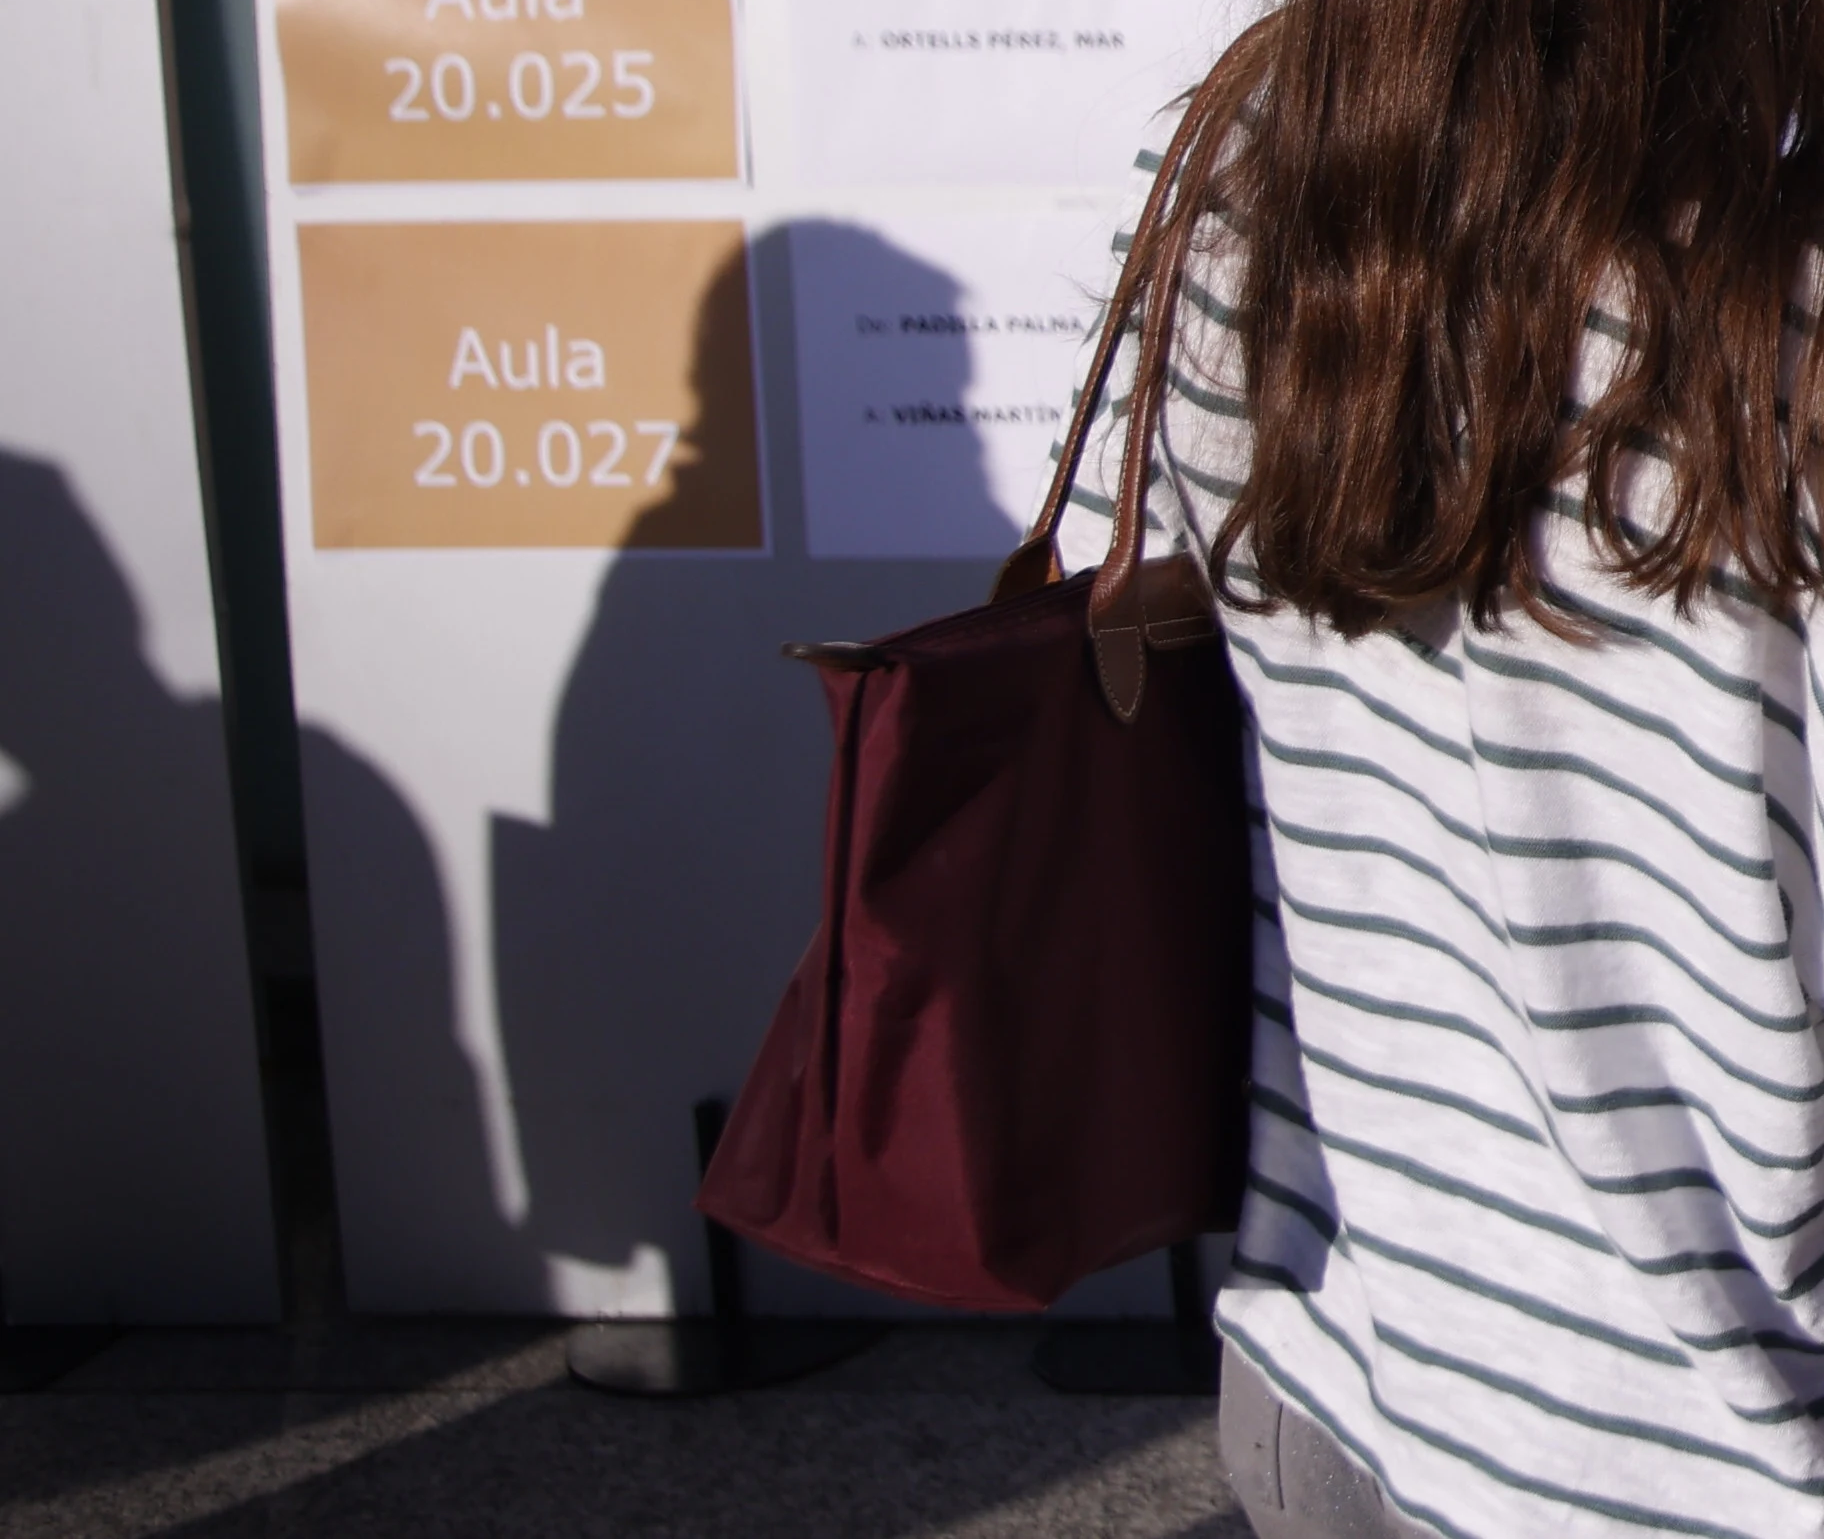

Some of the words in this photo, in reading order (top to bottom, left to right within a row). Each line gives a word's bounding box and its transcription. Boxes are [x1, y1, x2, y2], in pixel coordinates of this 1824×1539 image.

[1074, 30, 1126, 49] MAR
[383, 51, 656, 122] 20.025
[449, 325, 606, 392] Aula
[411, 421, 680, 489] 20.027
